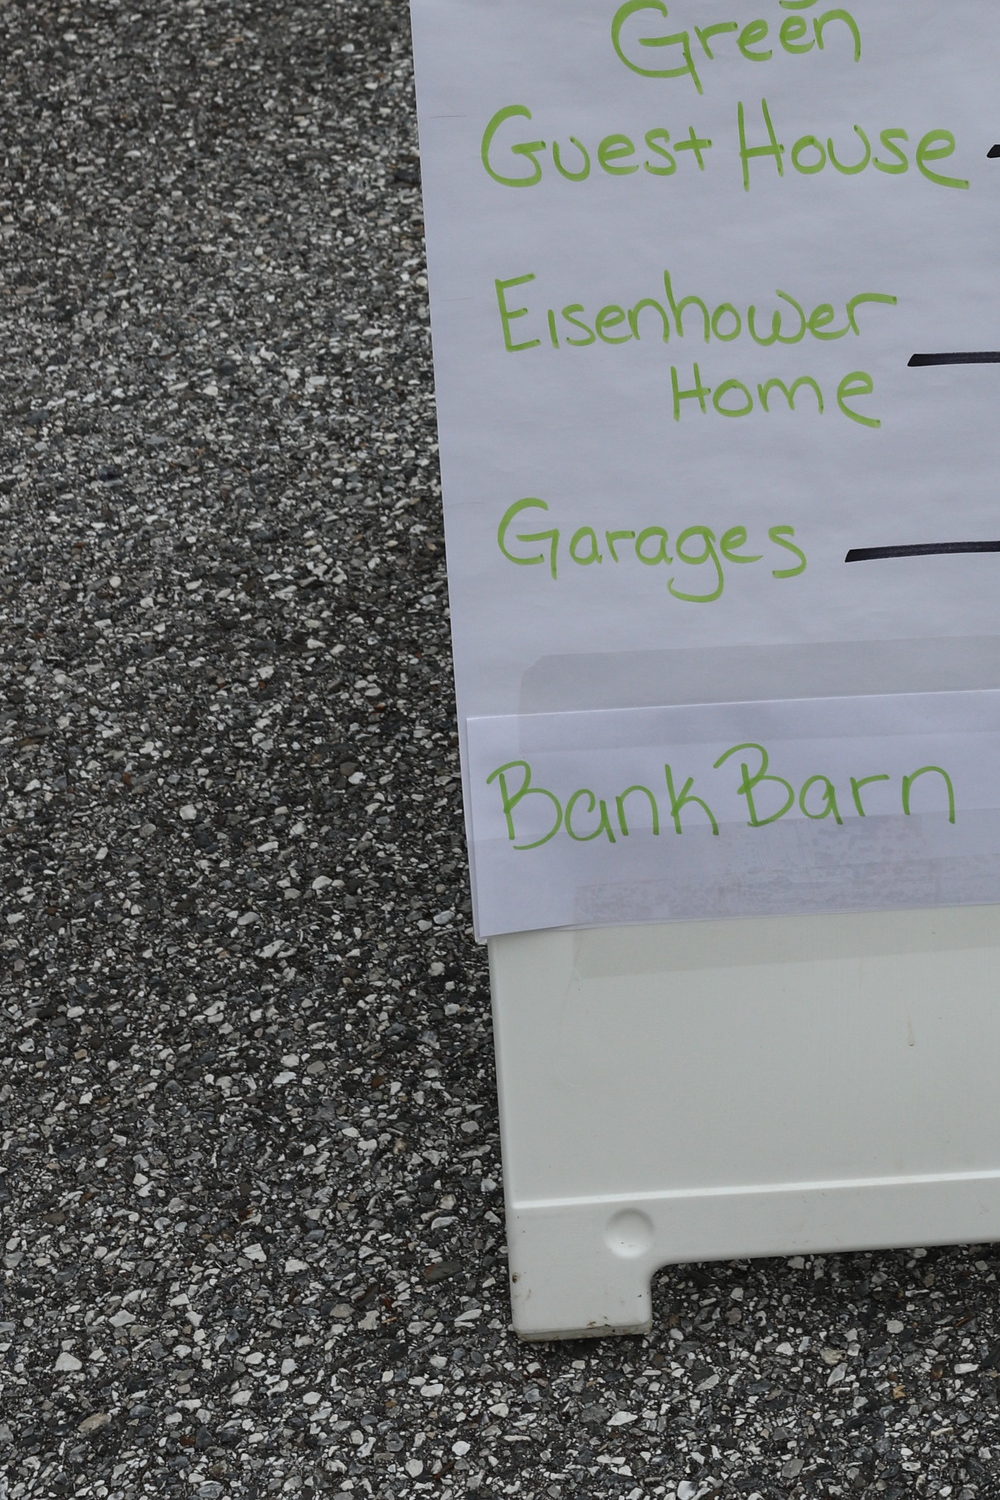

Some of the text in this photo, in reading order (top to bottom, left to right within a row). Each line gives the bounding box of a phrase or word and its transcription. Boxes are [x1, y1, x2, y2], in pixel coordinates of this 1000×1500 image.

[482, 105, 712, 186] Guest
[738, 100, 968, 190] House
[496, 271, 896, 351] Eisenhower
[671, 364, 880, 426] Home
[498, 498, 806, 602] Garages
[487, 761, 718, 849] Bank
[714, 744, 954, 826] Barn
